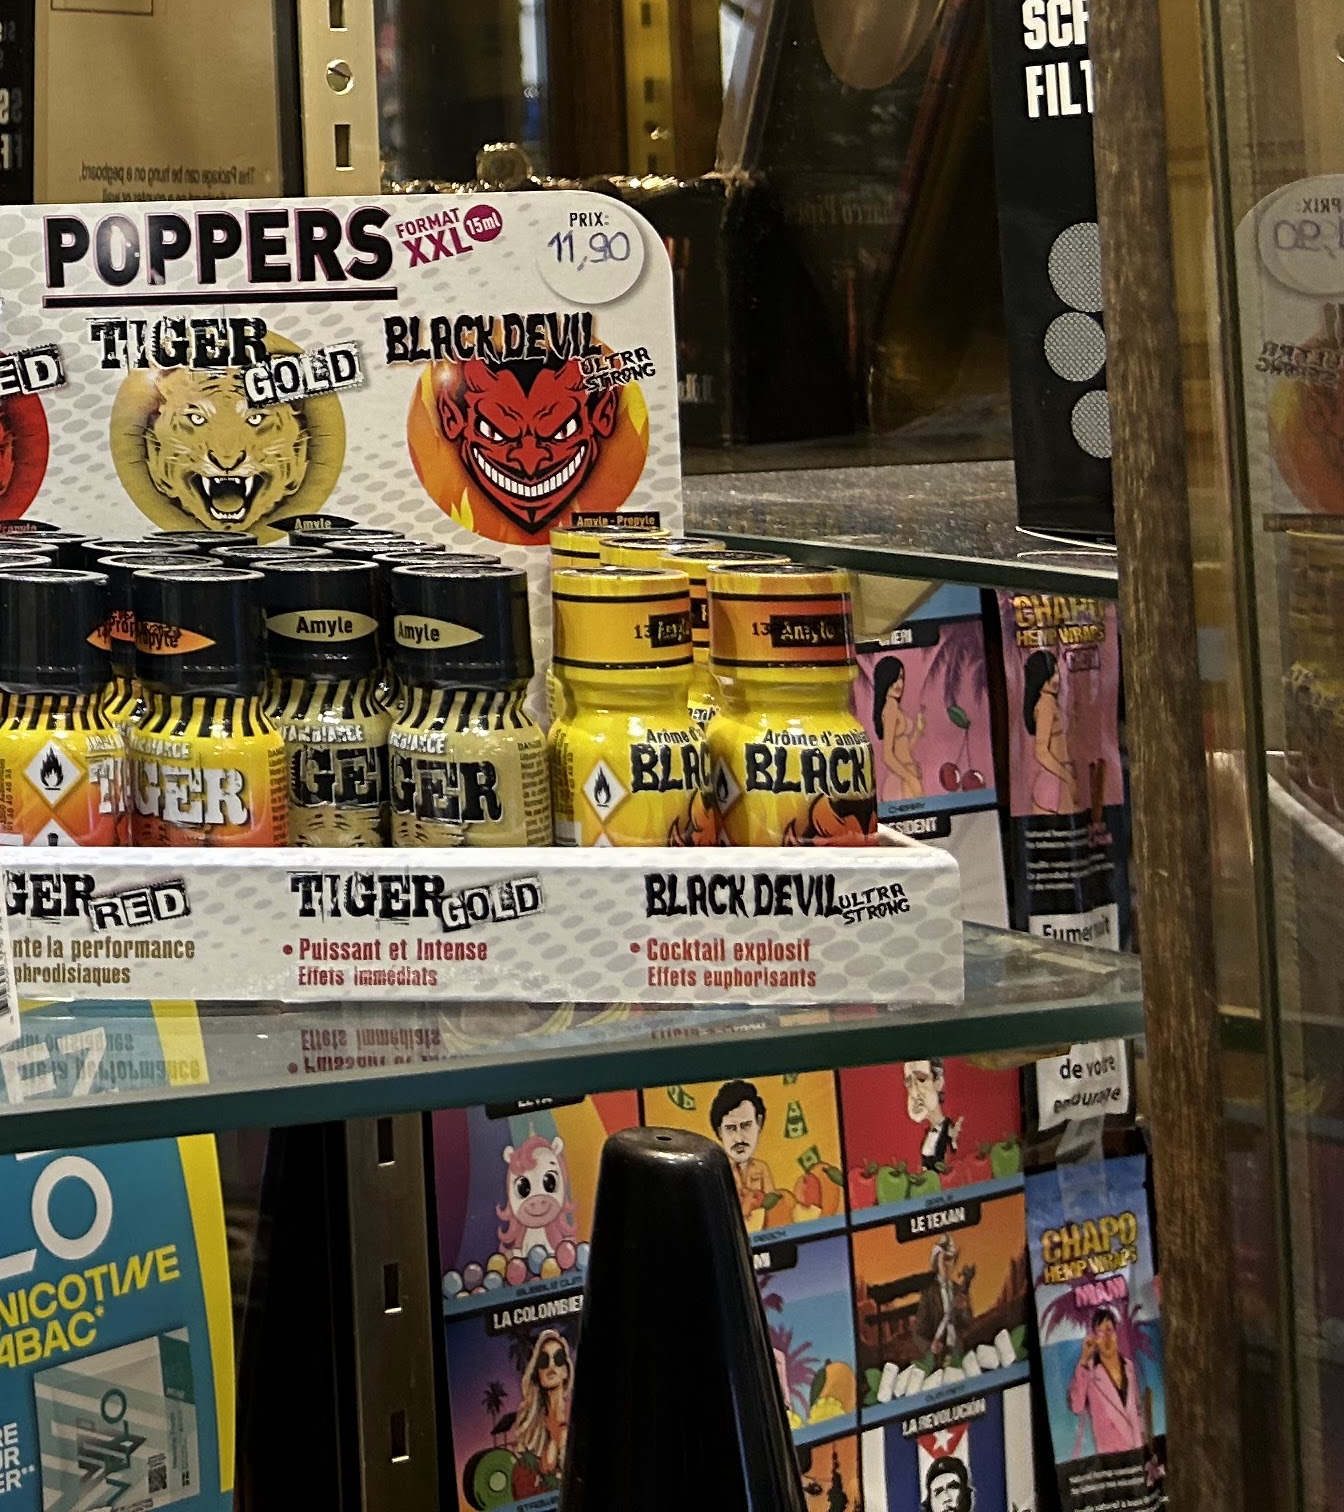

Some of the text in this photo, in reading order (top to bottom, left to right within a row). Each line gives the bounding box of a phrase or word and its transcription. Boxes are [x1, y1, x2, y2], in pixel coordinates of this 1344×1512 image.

[395, 208, 460, 238] FORMAT
[466, 212, 500, 235] 15ml
[569, 212, 609, 227] PRIX:
[43, 205, 394, 290] POPPERS
[402, 227, 473, 268] XXL
[547, 230, 630, 271] 11,90
[90, 315, 267, 373] TIGER
[384, 312, 602, 365] BLACK DEVIL
[244, 341, 363, 409] GOLD
[581, 347, 651, 374] ULTRA
[585, 362, 656, 393] STRONG
[296, 616, 354, 635] Amyle
[289, 871, 545, 932] TIGER GOLD
[645, 873, 842, 918] BLACK DEVIL
[838, 883, 906, 912] ULTRA
[842, 899, 911, 926] STRONG
[298, 937, 488, 962] Puissant et Intense
[646, 937, 812, 963] Cocktail explosif
[298, 964, 438, 987] Effets immédiats
[647, 966, 817, 989] Effets euphorisants
